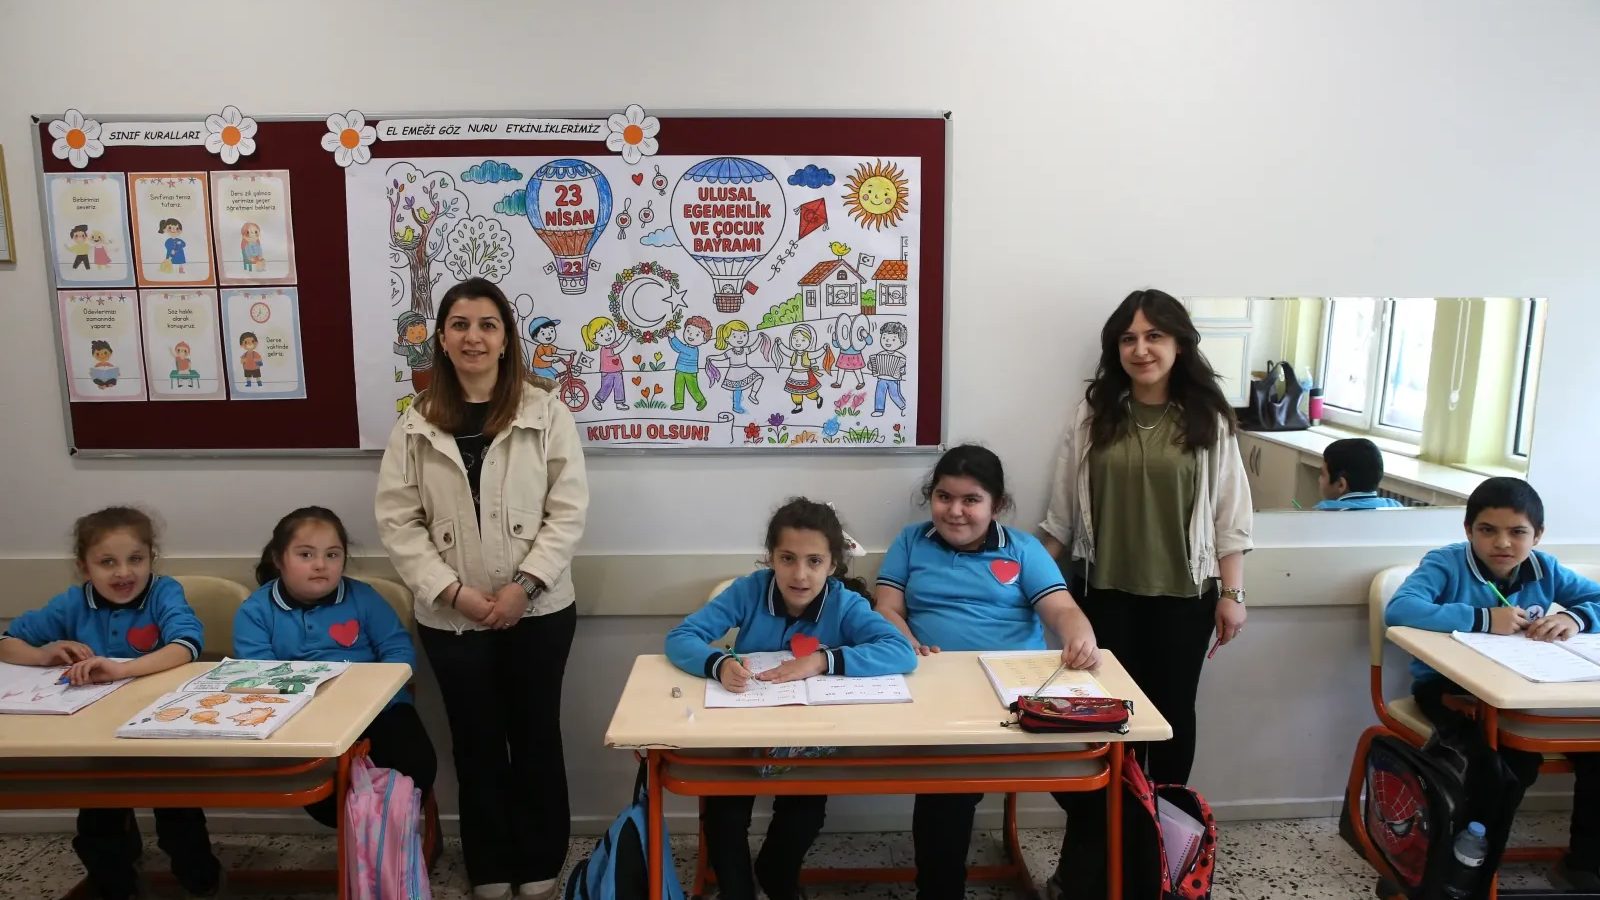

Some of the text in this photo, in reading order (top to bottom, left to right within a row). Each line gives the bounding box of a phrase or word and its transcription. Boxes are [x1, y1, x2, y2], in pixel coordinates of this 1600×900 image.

[109, 130, 201, 141] SINIF KURALLARI
[386, 123, 601, 136] EL EMEĞİ GÖZ NURU ETKİNLİKLERİMİZ
[554, 184, 583, 207] 23
[698, 187, 757, 201] ULUSAL
[545, 208, 595, 226] NİSAN
[683, 201, 772, 218] EGEMENLİK
[690, 221, 765, 238] VE ÇOCUK
[694, 238, 761, 252] BAYRAMI
[563, 261, 583, 275] 23
[587, 423, 710, 441] KUTLU OLSUN!
